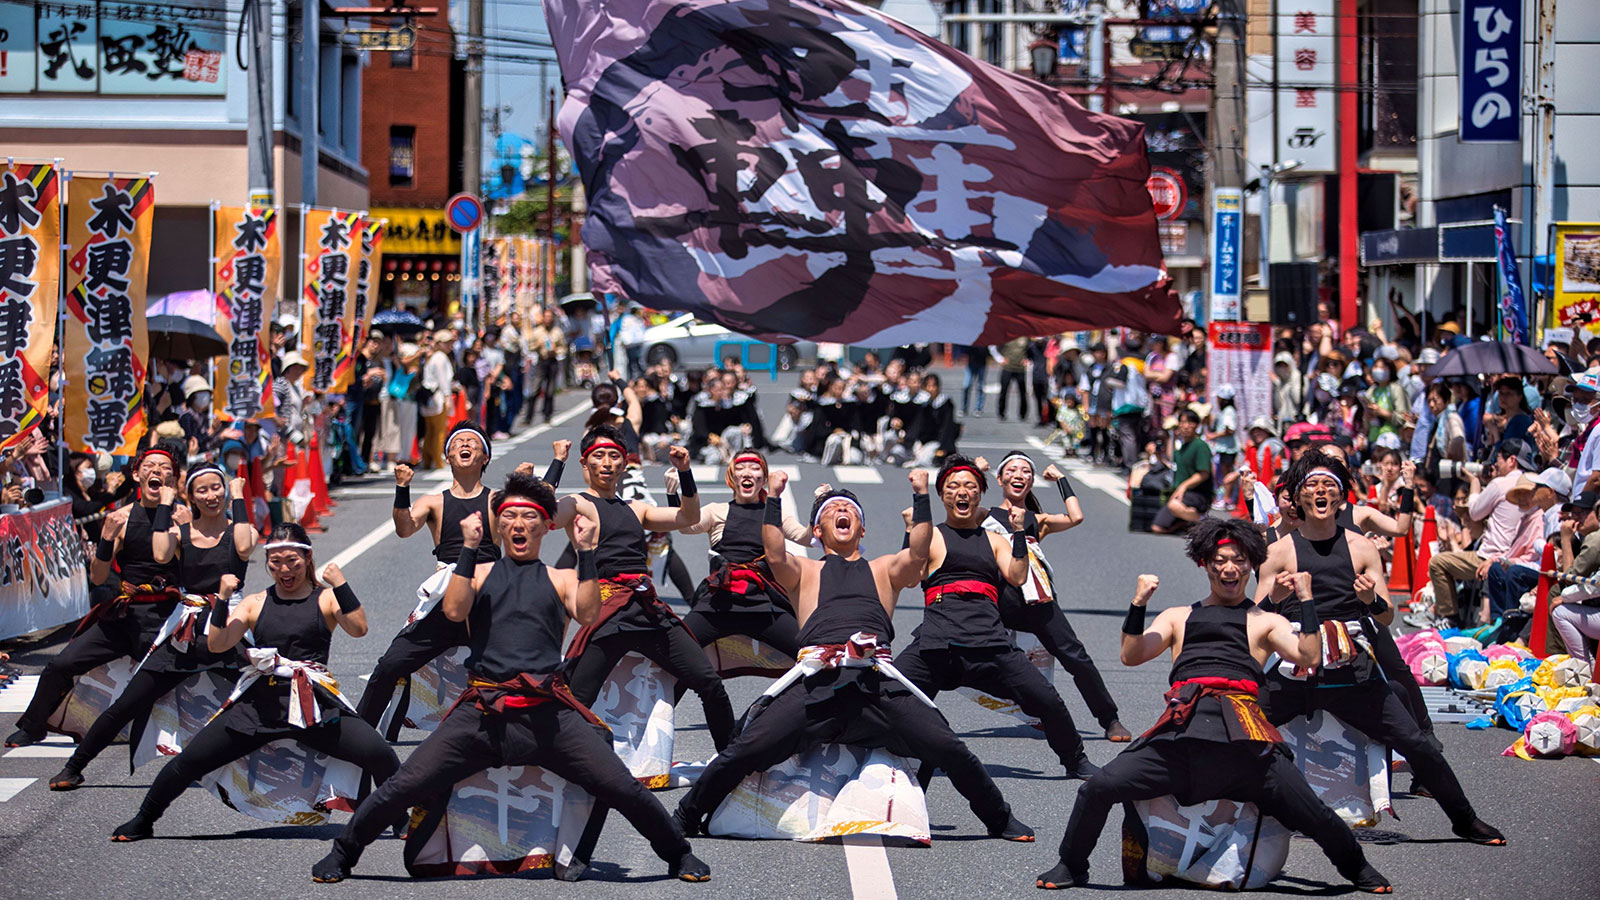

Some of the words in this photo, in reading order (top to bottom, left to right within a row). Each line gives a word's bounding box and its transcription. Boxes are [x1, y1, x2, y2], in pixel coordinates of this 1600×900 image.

[40, 22, 200, 80] 武田塾
[1294, 11, 1317, 107] 美容室
[1472, 6, 1513, 128] ひらの
[1221, 215, 1235, 292] ホームネット
